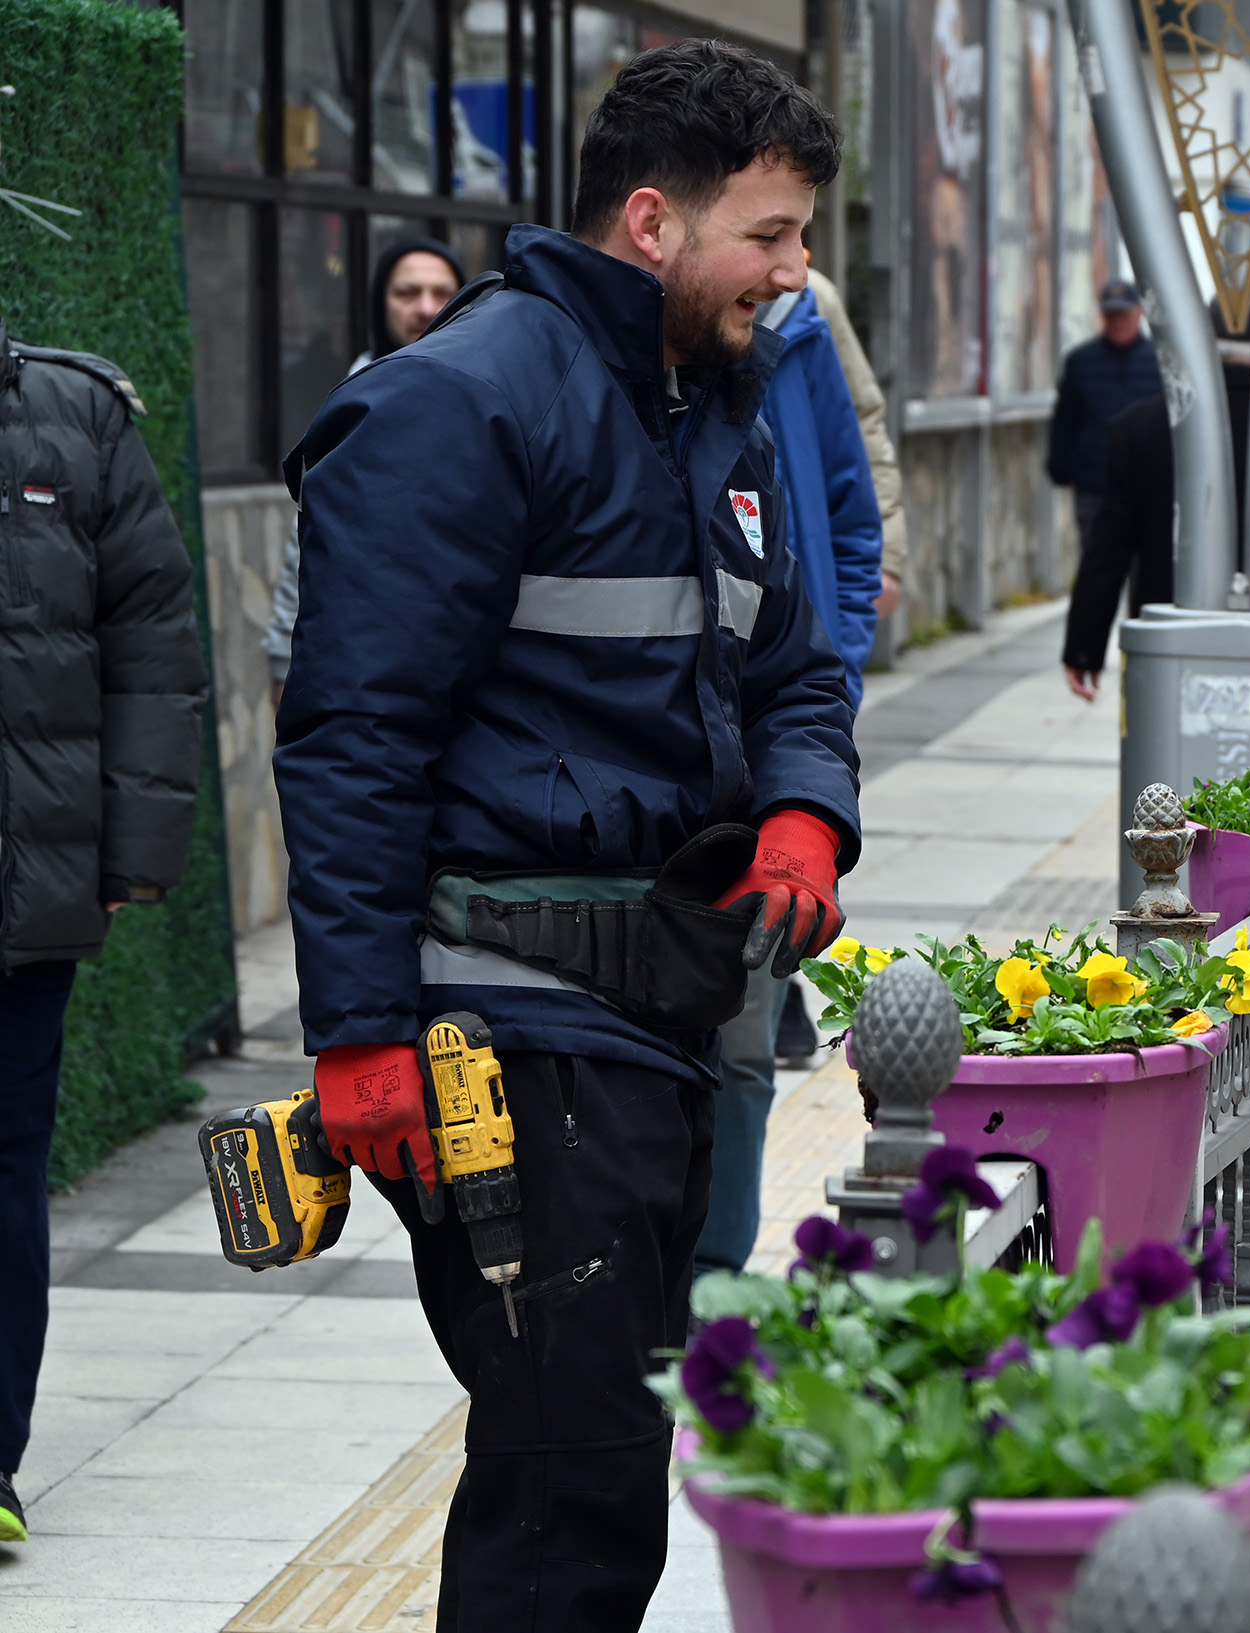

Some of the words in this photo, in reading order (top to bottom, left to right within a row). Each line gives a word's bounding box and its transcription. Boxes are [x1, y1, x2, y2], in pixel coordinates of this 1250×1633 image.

[221, 1136, 232, 1157] 18V
[224, 1161, 240, 1188] XR
[250, 1169, 266, 1206] DEWALT
[232, 1190, 243, 1219] VOLT
[235, 1187, 249, 1220] FLEX
[240, 1224, 252, 1248] 54V
